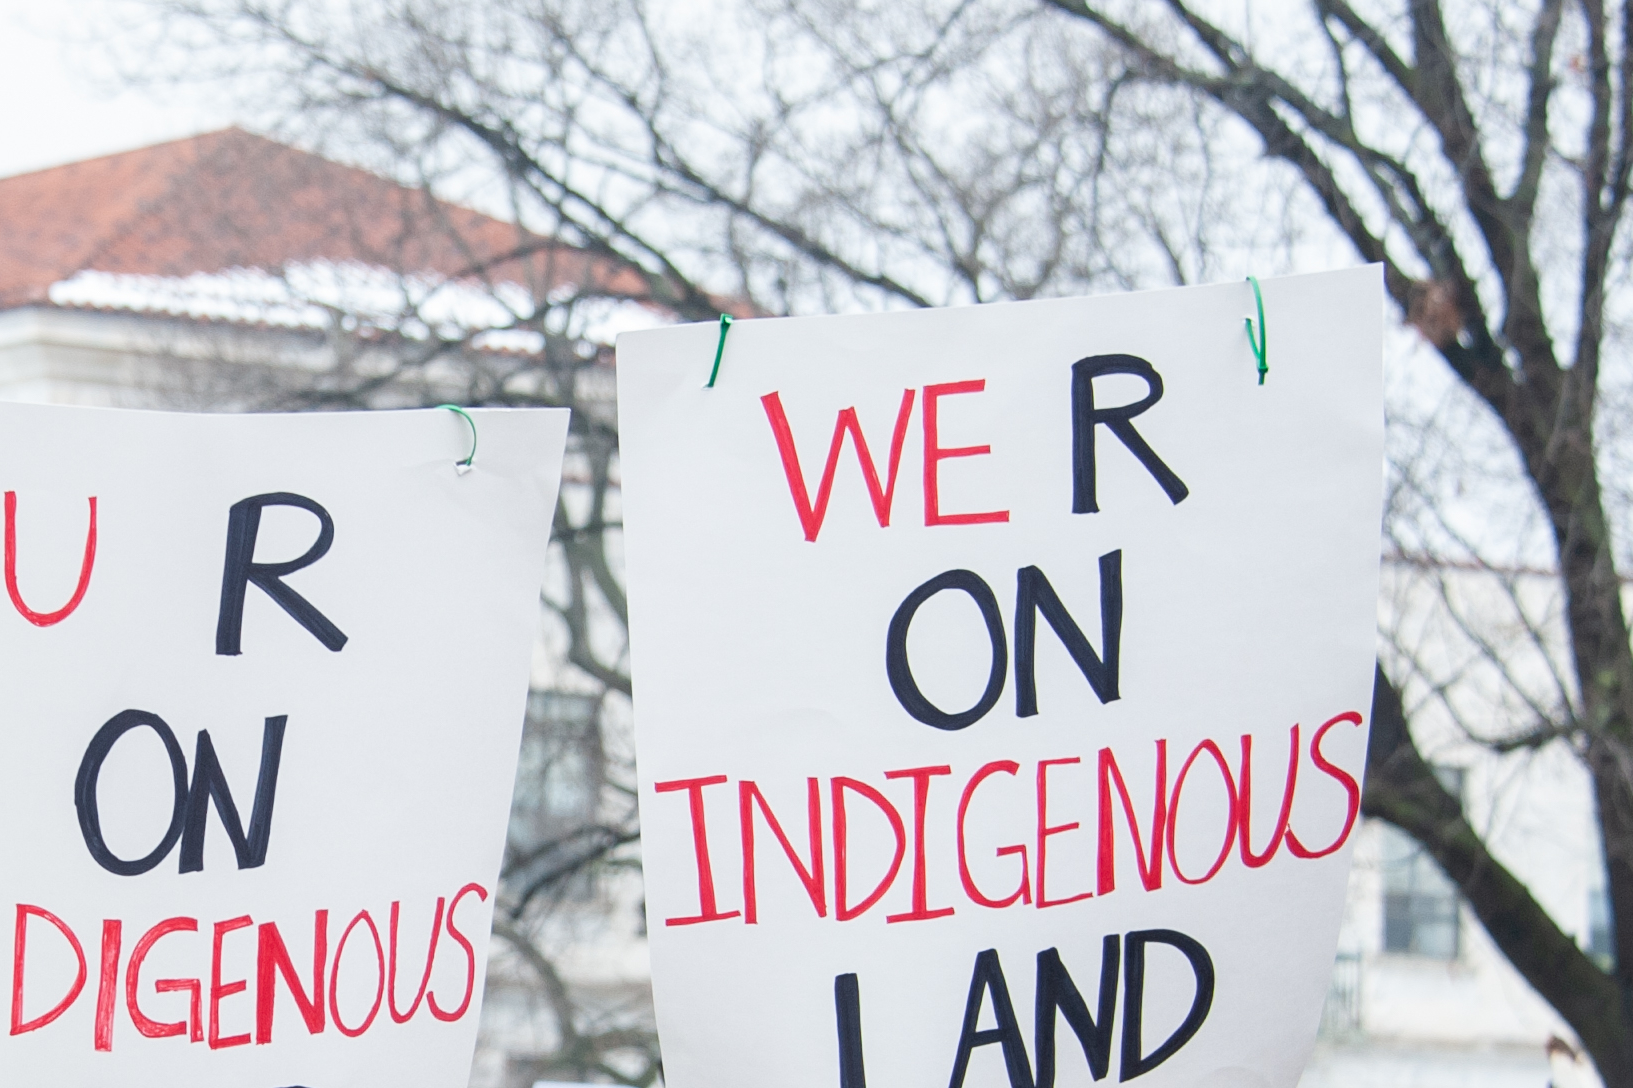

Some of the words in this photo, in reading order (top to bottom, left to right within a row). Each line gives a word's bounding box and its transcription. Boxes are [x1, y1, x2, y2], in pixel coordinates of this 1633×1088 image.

[761, 379, 1009, 542] WE
[1072, 354, 1188, 513] R
[5, 491, 96, 627] U
[217, 493, 347, 655] R
[887, 550, 1122, 730] ON
[75, 710, 287, 875] ON
[655, 710, 1364, 926] INDIGENOUS
